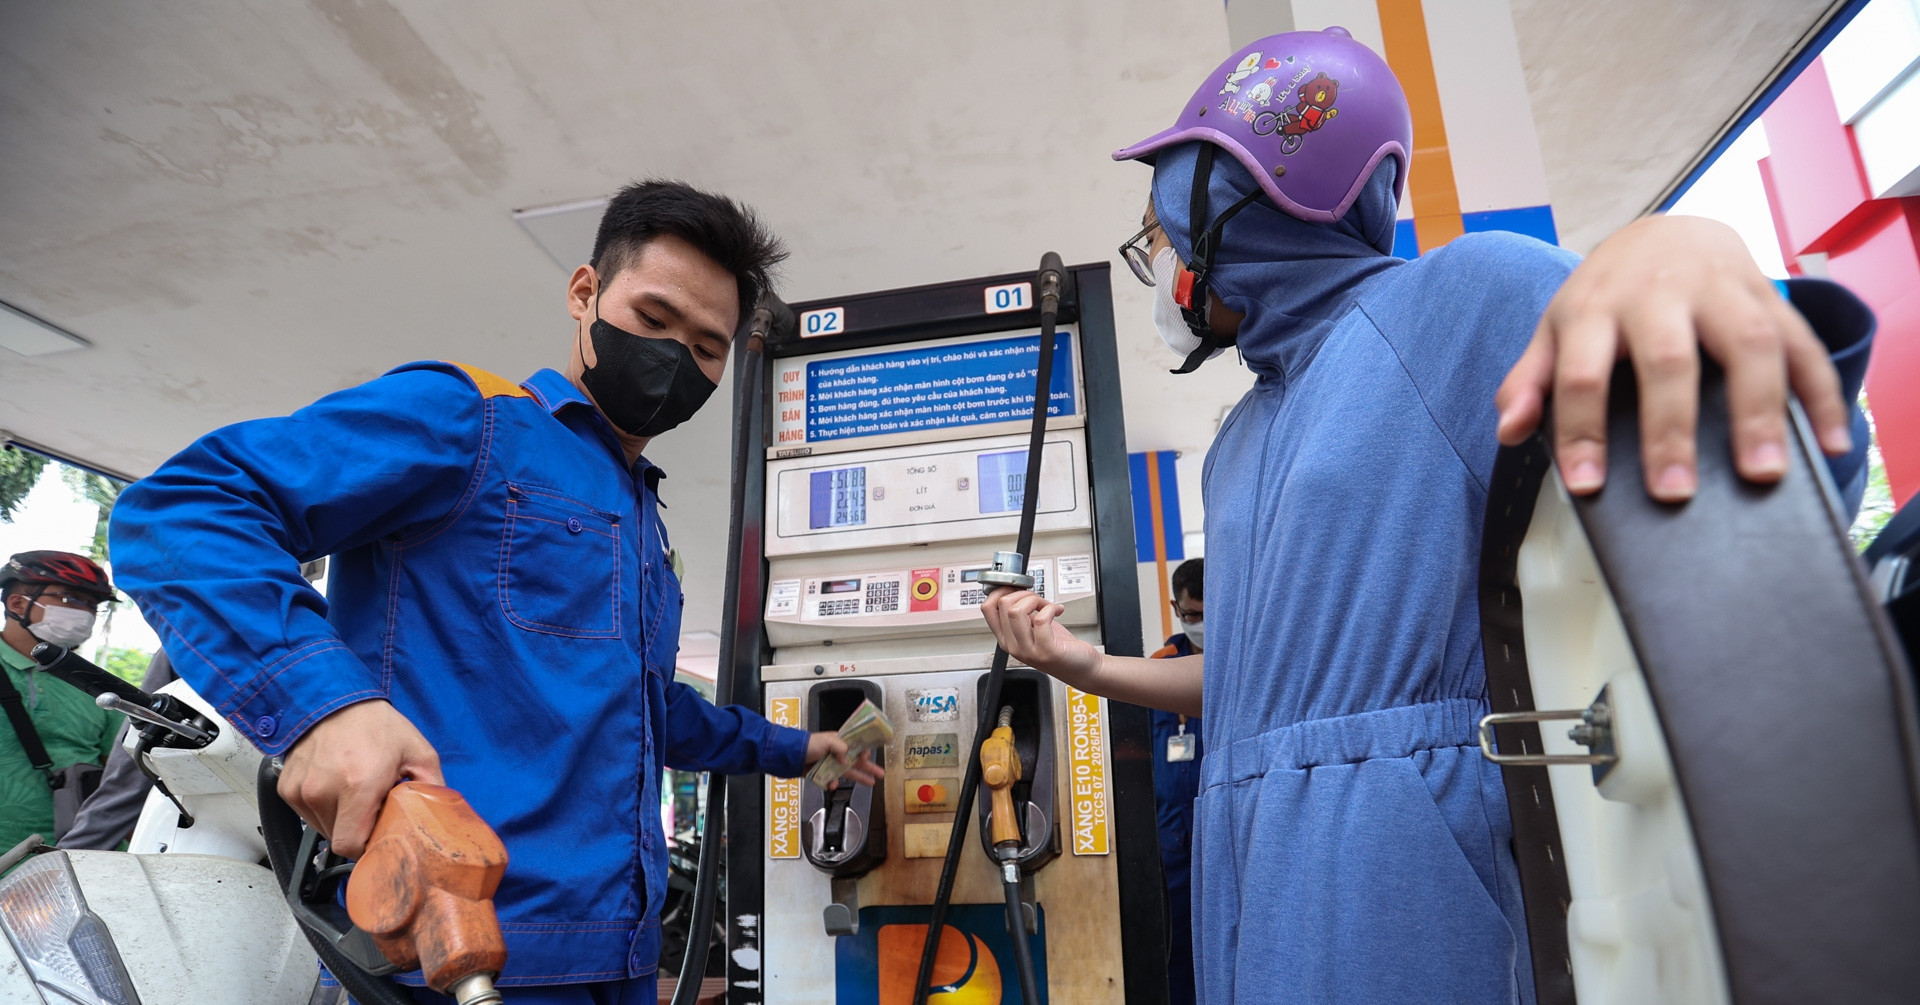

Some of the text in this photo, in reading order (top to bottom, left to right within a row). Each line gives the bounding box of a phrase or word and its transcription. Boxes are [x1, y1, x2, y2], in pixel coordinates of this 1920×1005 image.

[995, 287, 1022, 308] 01
[807, 312, 837, 334] 02
[818, 368, 844, 376] Hướng
[862, 362, 884, 371] khách
[886, 361, 905, 369] hàng
[922, 357, 929, 365] vị
[943, 353, 962, 361] chào
[964, 351, 976, 359] hỏi
[1005, 346, 1024, 355] nhận
[783, 370, 800, 383] QUY
[818, 392, 832, 400] Mời
[834, 390, 856, 398] khách
[858, 388, 877, 396] hàng
[894, 383, 913, 392] nhận
[952, 378, 964, 386] cột
[986, 374, 1006, 382] đang
[1016, 369, 1026, 378] số
[833, 378, 856, 387] khách
[779, 389, 804, 403] TRÌNH
[818, 404, 836, 413] Bơm
[838, 402, 856, 410] hàng
[912, 394, 926, 403] yêu
[959, 388, 983, 396] khách
[782, 408, 800, 422] BÁN
[818, 417, 832, 425] Mời
[834, 414, 856, 423] khách
[894, 408, 913, 416] nhận
[953, 402, 965, 410] cột
[987, 398, 1010, 406] trước
[779, 428, 803, 442] HÀNG
[818, 429, 837, 437] Thực
[839, 426, 855, 435] hiện
[880, 422, 897, 430] toán
[926, 417, 945, 425] nhận
[947, 414, 959, 423] kết
[778, 448, 810, 457] TATSUNO
[916, 485, 927, 494] LÍT
[1089, 712, 1102, 766] 2026/PLX
[908, 746, 942, 757] napas
[1072, 688, 1094, 850] XĂNG E10 RON95-V
[1093, 775, 1103, 790] 07
[789, 783, 798, 830] TCCS 07
[1094, 791, 1105, 825] TCCS
[772, 807, 788, 854] XĂNG
